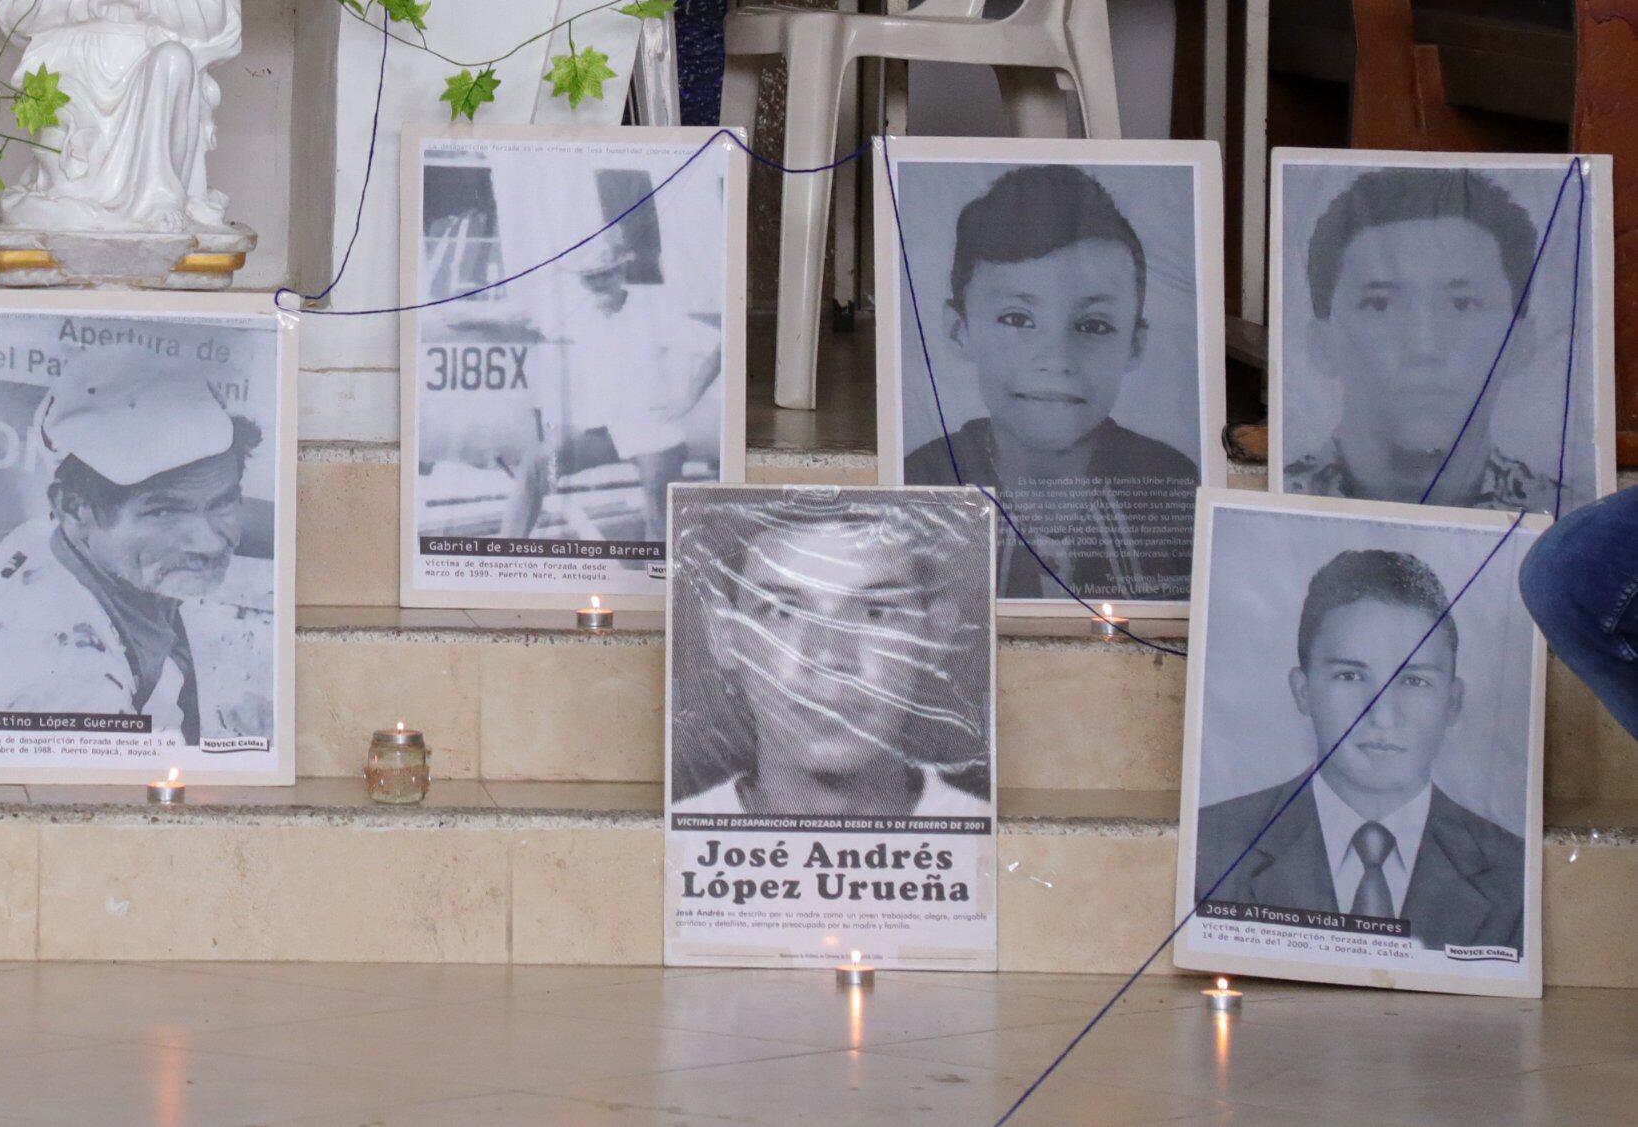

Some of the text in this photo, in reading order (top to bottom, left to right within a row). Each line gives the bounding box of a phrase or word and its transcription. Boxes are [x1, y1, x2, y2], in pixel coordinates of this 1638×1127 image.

[58, 319, 231, 364] Apertura de
[426, 346, 528, 391] 3186X
[429, 540, 659, 555] Gabriel de Jesús Gallego Barrera
[39, 717, 75, 728] López
[83, 718, 143, 728] Guerrero
[677, 818, 714, 826] VÍCTIMA
[716, 818, 728, 826] DE
[730, 818, 796, 827] DESAPARICIÓN
[799, 819, 841, 827] FORZADA
[844, 820, 872, 828] DESDE
[874, 820, 883, 828] EL
[886, 820, 892, 828] 9
[908, 820, 947, 829] FEBRERO
[950, 821, 961, 829] DE
[964, 821, 984, 829] 2001
[698, 840, 953, 870] José Andrés
[682, 871, 970, 904] López Urueña
[1207, 904, 1401, 932] José Alfonso Vidal Torres
